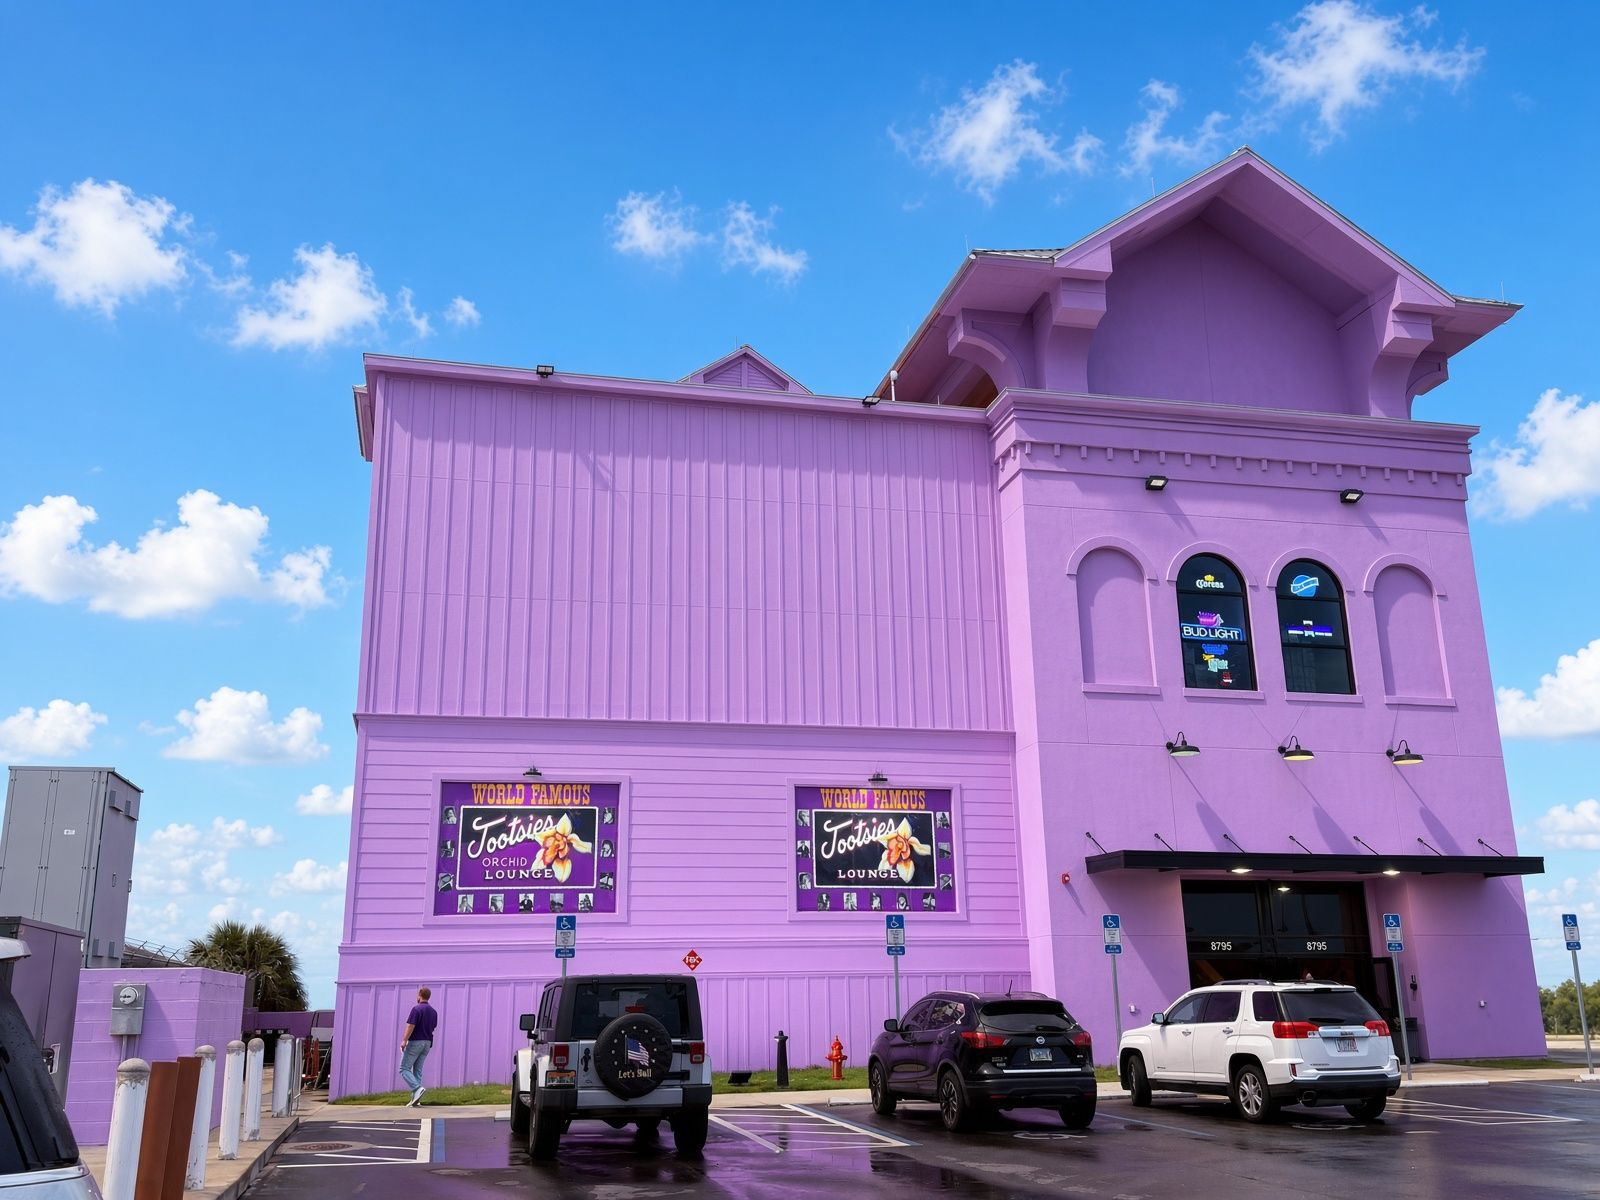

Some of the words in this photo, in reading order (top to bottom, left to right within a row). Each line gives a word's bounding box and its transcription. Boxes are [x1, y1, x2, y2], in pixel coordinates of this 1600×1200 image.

[1183, 626, 1208, 637] BUD
[1208, 628, 1240, 640] LIGHT
[471, 783, 525, 805] WORLD
[530, 784, 591, 806] FAMOUS
[820, 788, 868, 809] WORLD
[873, 789, 926, 810] FAMOUS
[467, 814, 555, 859] Tootsies
[820, 817, 896, 859] Tootsies
[482, 857, 528, 867] ORCHID
[484, 869, 553, 880] LOUNGE
[837, 869, 899, 879] LOUNGE
[1210, 941, 1232, 951] 8795
[1306, 941, 1327, 951] 8795
[618, 1070, 635, 1079] Let's
